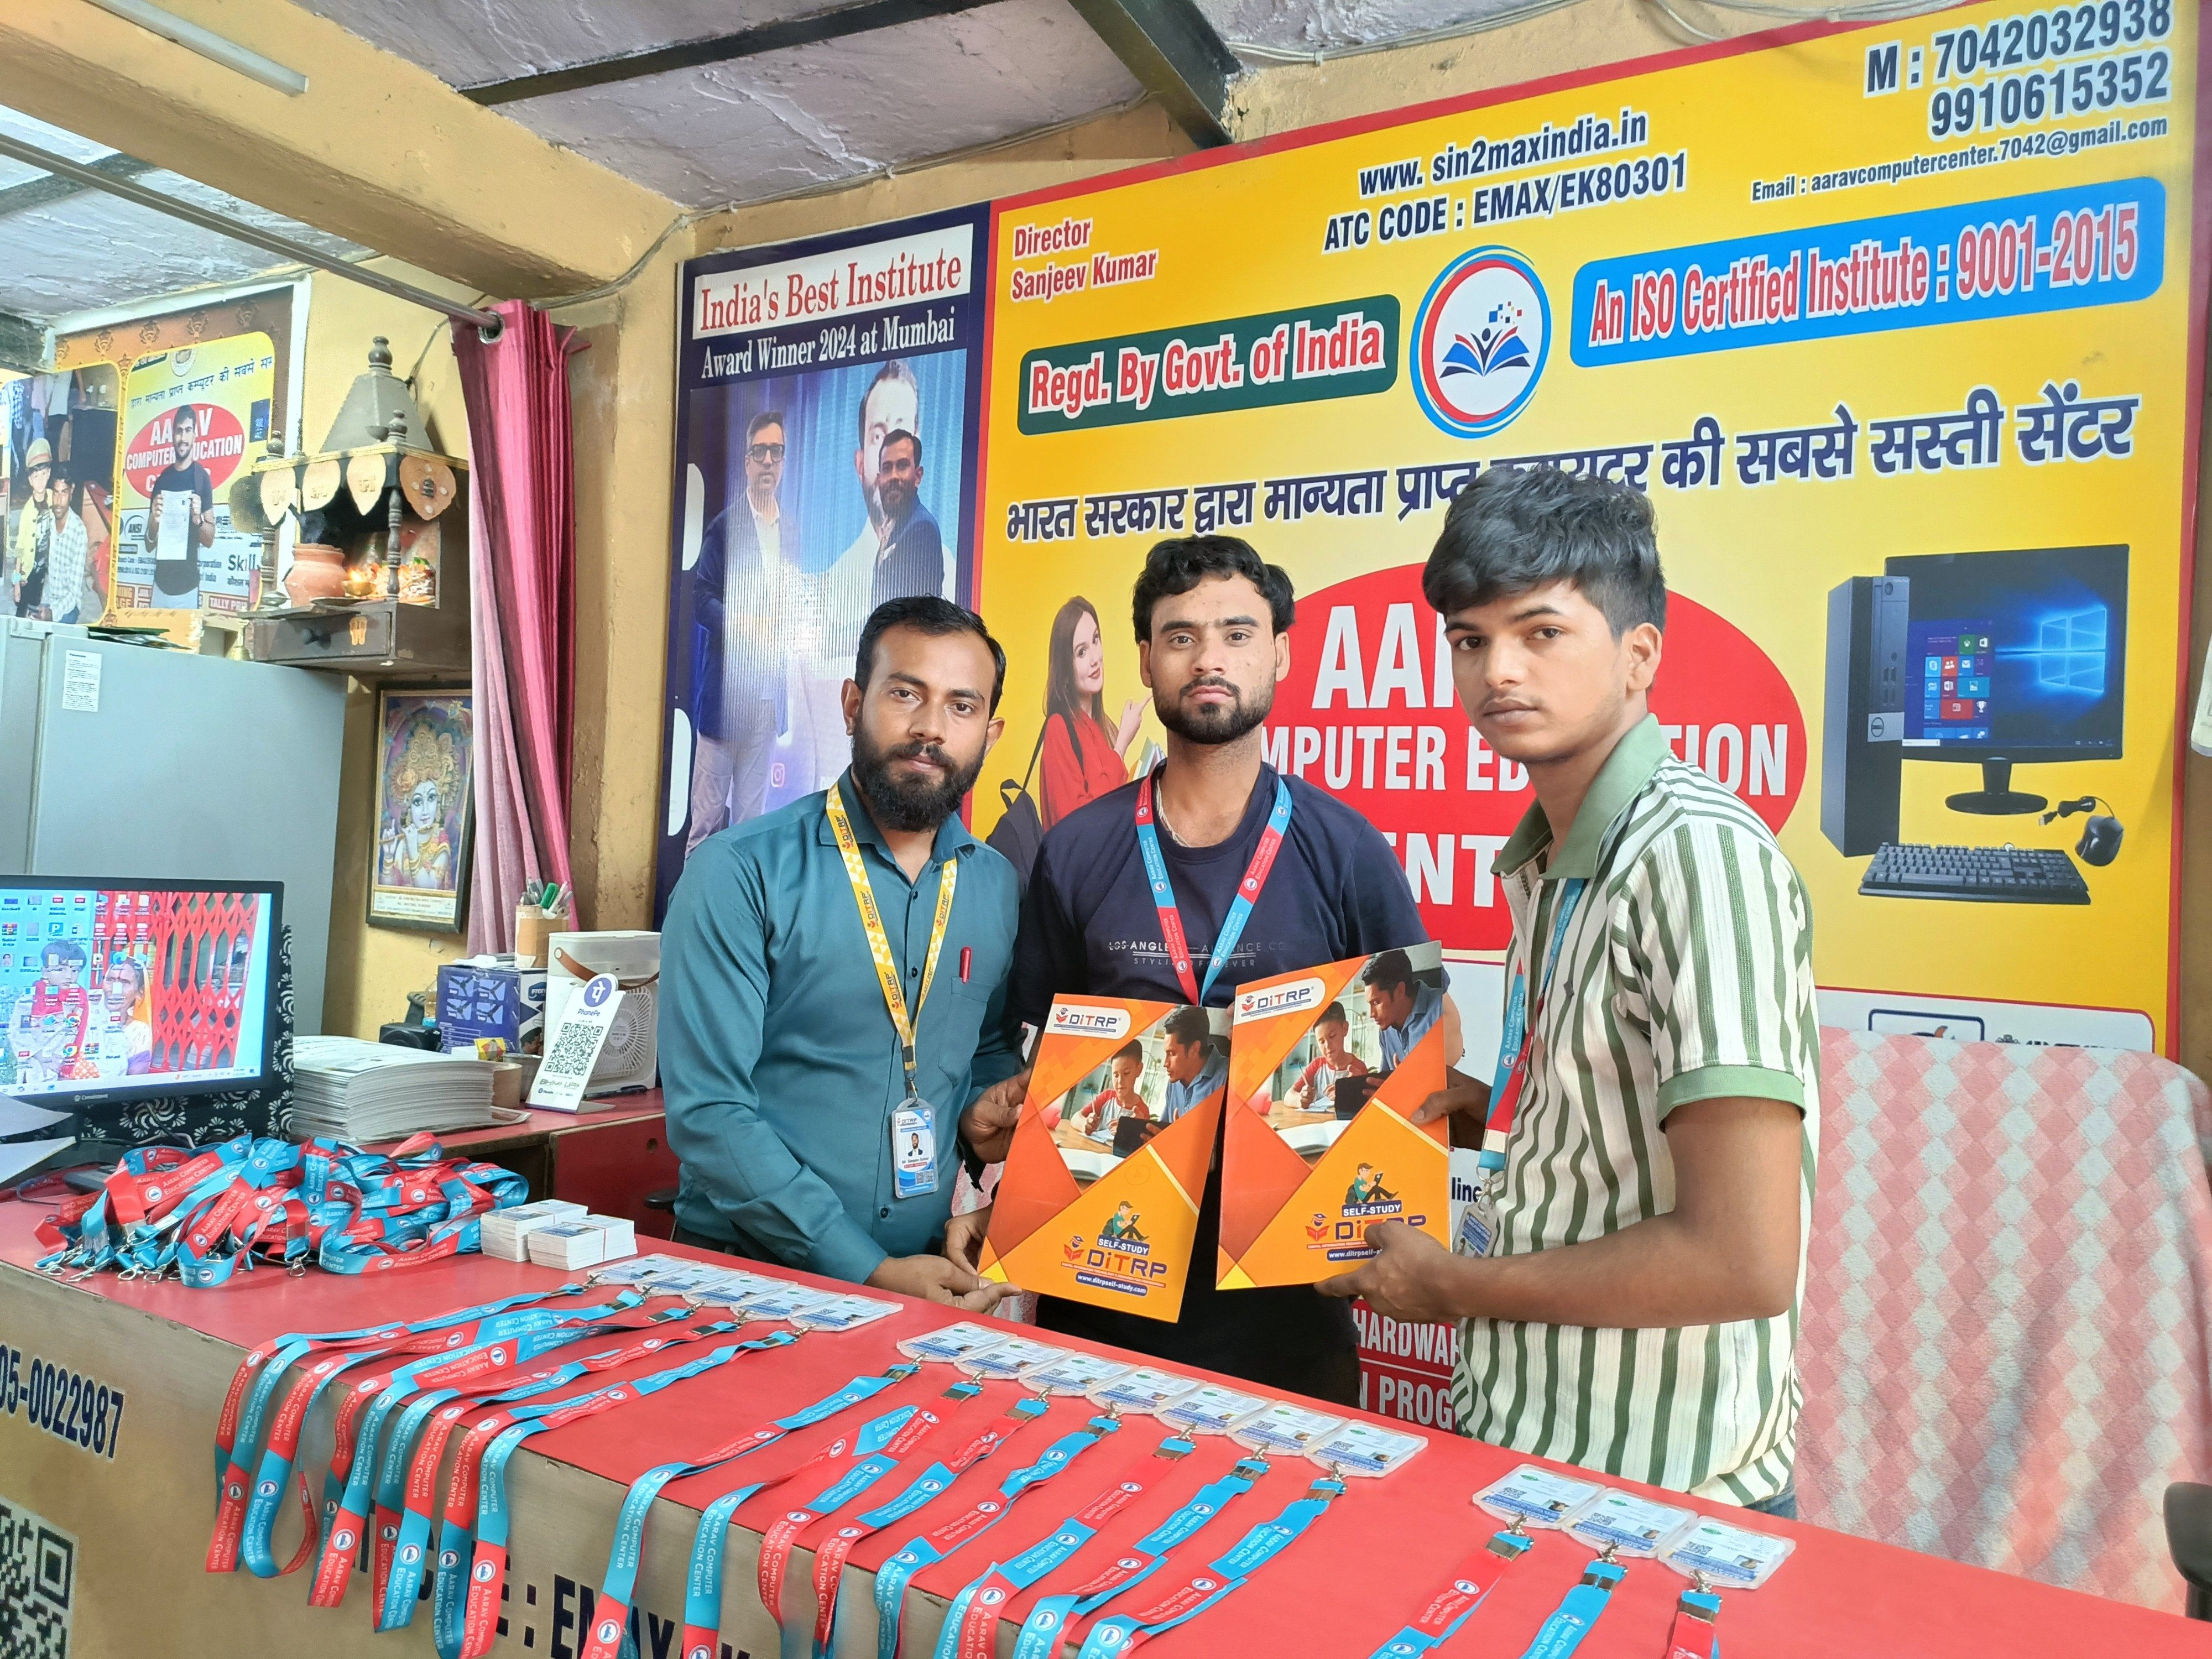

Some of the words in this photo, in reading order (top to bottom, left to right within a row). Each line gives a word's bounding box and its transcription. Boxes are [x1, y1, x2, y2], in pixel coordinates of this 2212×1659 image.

[1867, 45, 1897, 92] M
[1934, 0, 2170, 79] 7042032938
[1932, 51, 2168, 135] 9910615352
[1360, 161, 1423, 195] www.
[1433, 110, 1646, 181] sin2maxindia.in
[1751, 179, 1796, 201] Email
[1811, 117, 2167, 192] aaravcomputercenter.7042@gmail.com
[1324, 213, 1370, 251] ATC
[1379, 196, 1447, 240] CODE
[1473, 152, 1686, 223] EMAX/EK80301
[1014, 220, 1091, 257] Director
[701, 279, 779, 331] India's
[785, 269, 839, 317] Best
[846, 248, 961, 306] Institute
[1012, 264, 1087, 300] Sanjeev
[1093, 250, 1157, 285] Kumar
[1589, 280, 1624, 344] An
[1631, 267, 1675, 338] ISO
[1682, 253, 1797, 331] Certified
[1807, 236, 1927, 314] Institute
[1957, 205, 2138, 300] 9001-2015
[701, 340, 752, 379] Award
[758, 336, 816, 368] Winner
[819, 324, 856, 362] 2024
[860, 322, 878, 355] at
[881, 306, 954, 352] Mumbai
[220, 367, 229, 381] की
[234, 358, 254, 377] सबसे
[1032, 356, 1108, 414] Regd.
[1120, 351, 1157, 405] By
[1166, 338, 1241, 390] Govt.
[1254, 329, 1285, 379] of
[1296, 317, 1380, 373] India
[150, 408, 213, 446] AAV
[194, 435, 242, 461] UCATION
[1007, 497, 1077, 541] भारत
[1084, 486, 1188, 536] सरकार
[1194, 481, 1255, 531] द्वारा
[1264, 469, 1389, 521] मान्यता
[1661, 414, 1725, 488] की
[1736, 403, 1858, 484] सबसे
[1869, 386, 2005, 474] सस्ती
[2017, 381, 2141, 461] सेंटर
[1261, 726, 1447, 791] MPUTER
[1130, 941, 1170, 952] ANGLE
[578, 1008, 600, 1016] PhonePe
[1343, 1204, 1401, 1217] SELF-STUDY
[1098, 1238, 1149, 1255] SELF-STUDY
[1329, 1249, 1383, 1258] www.ditrpself-s
[1078, 1274, 1146, 1294] www.ditrpself-study.com
[286, 1374, 311, 1411] EDUCATION
[298, 1376, 314, 1402] AARAV
[274, 1413, 287, 1441] CENTER
[284, 1404, 300, 1441] COMPUTER
[360, 1411, 375, 1454] EDUCATION
[369, 1416, 379, 1444] AARAV
[434, 1425, 448, 1452] AARAV
[419, 1421, 443, 1465] EDUCATION
[454, 1431, 476, 1474] EDUCATION
[465, 1437, 479, 1463] AARAV
[481, 1439, 504, 1484] EDUCATION
[491, 1442, 508, 1470] AARAV
[352, 1455, 364, 1486] CENTER
[362, 1444, 373, 1486] COMPUTER
[413, 1467, 424, 1499] CENTER
[422, 1454, 436, 1498] COMPUTER
[447, 1475, 459, 1507] CENTER
[458, 1464, 469, 1507] COMPUTER
[481, 1485, 489, 1515] CENTER
[489, 1472, 498, 1513] COMPUTER
[637, 1487, 656, 1515] AARAV
[625, 1483, 650, 1531] EDUCATION
[627, 1519, 641, 1568] COMPUTER
[697, 1509, 717, 1560] EDUCATION
[709, 1513, 724, 1545] AARAV
[616, 1533, 630, 1569] CENTER
[693, 1563, 703, 1597] CENTER
[706, 1548, 716, 1595] COMPUTER
